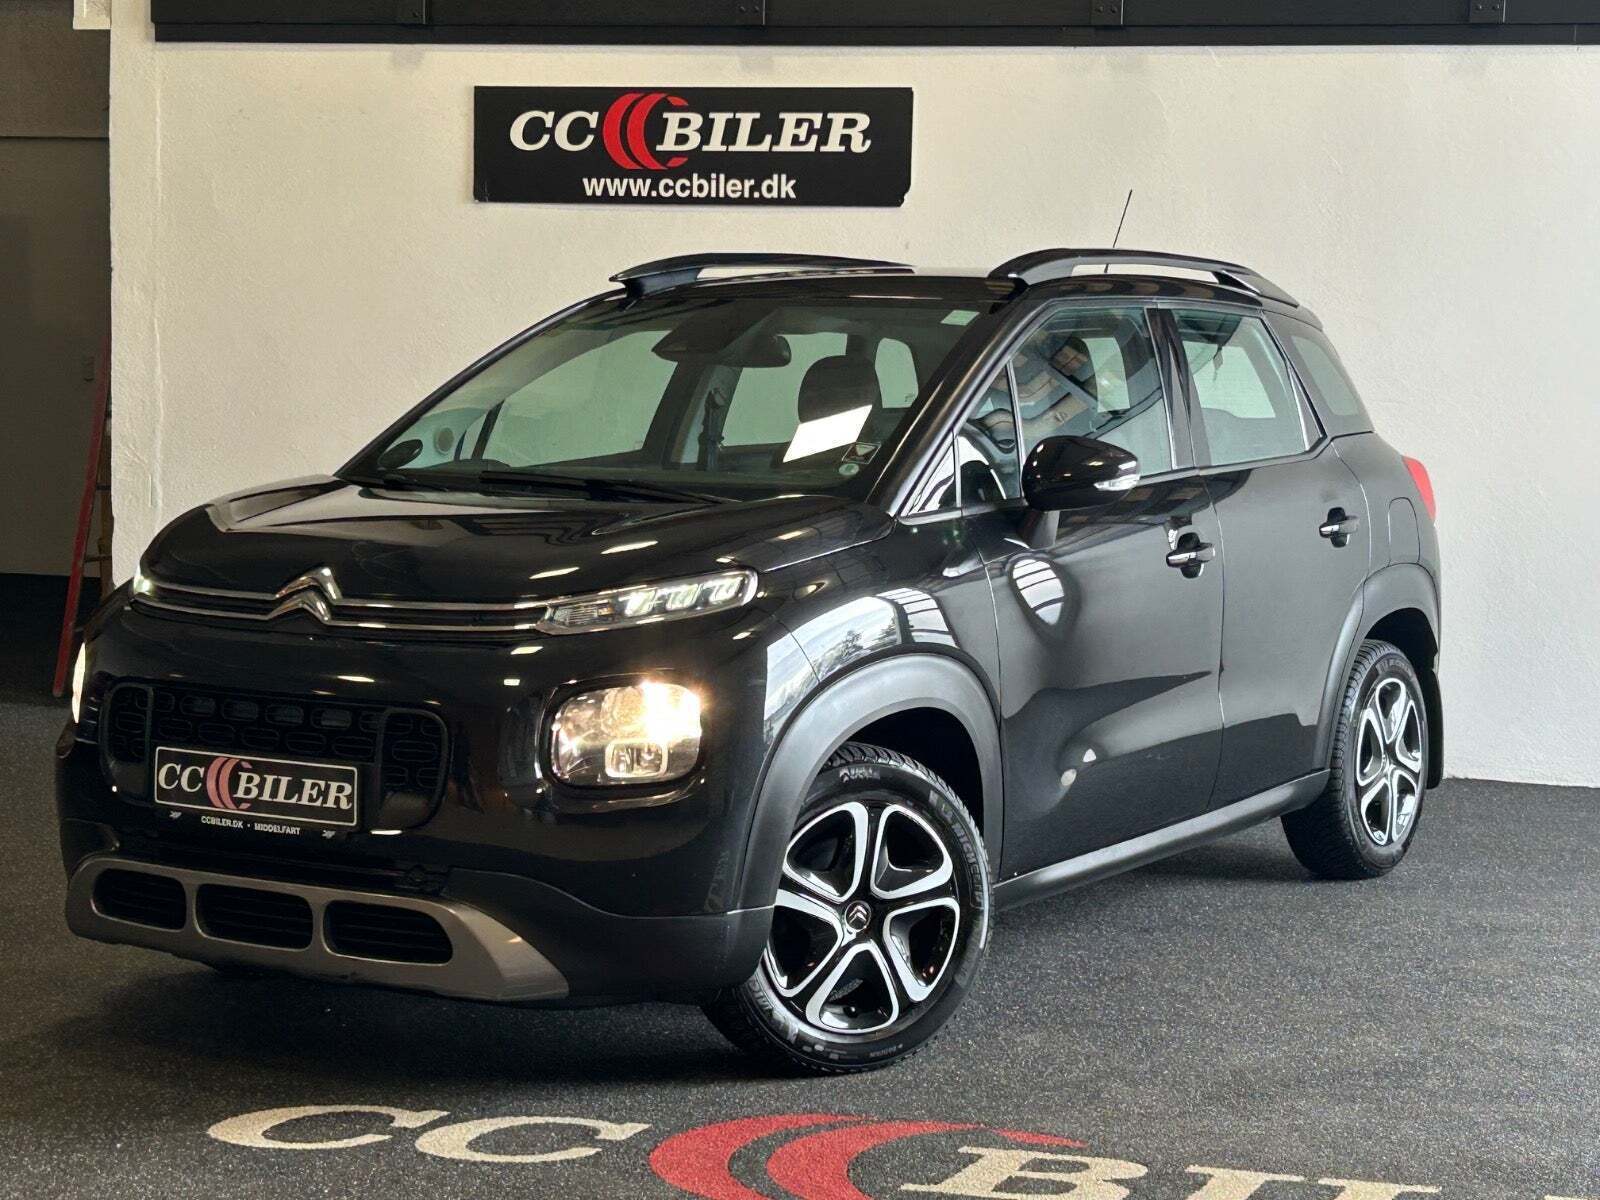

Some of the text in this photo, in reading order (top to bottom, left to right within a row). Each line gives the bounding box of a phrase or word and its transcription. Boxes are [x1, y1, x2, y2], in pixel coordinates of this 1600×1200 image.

[655, 112, 872, 154] BILER
[582, 172, 797, 199] www.ccbiler.dk
[232, 771, 353, 810] BILER
[200, 815, 301, 836] CCBILER.DK MIDDELFART
